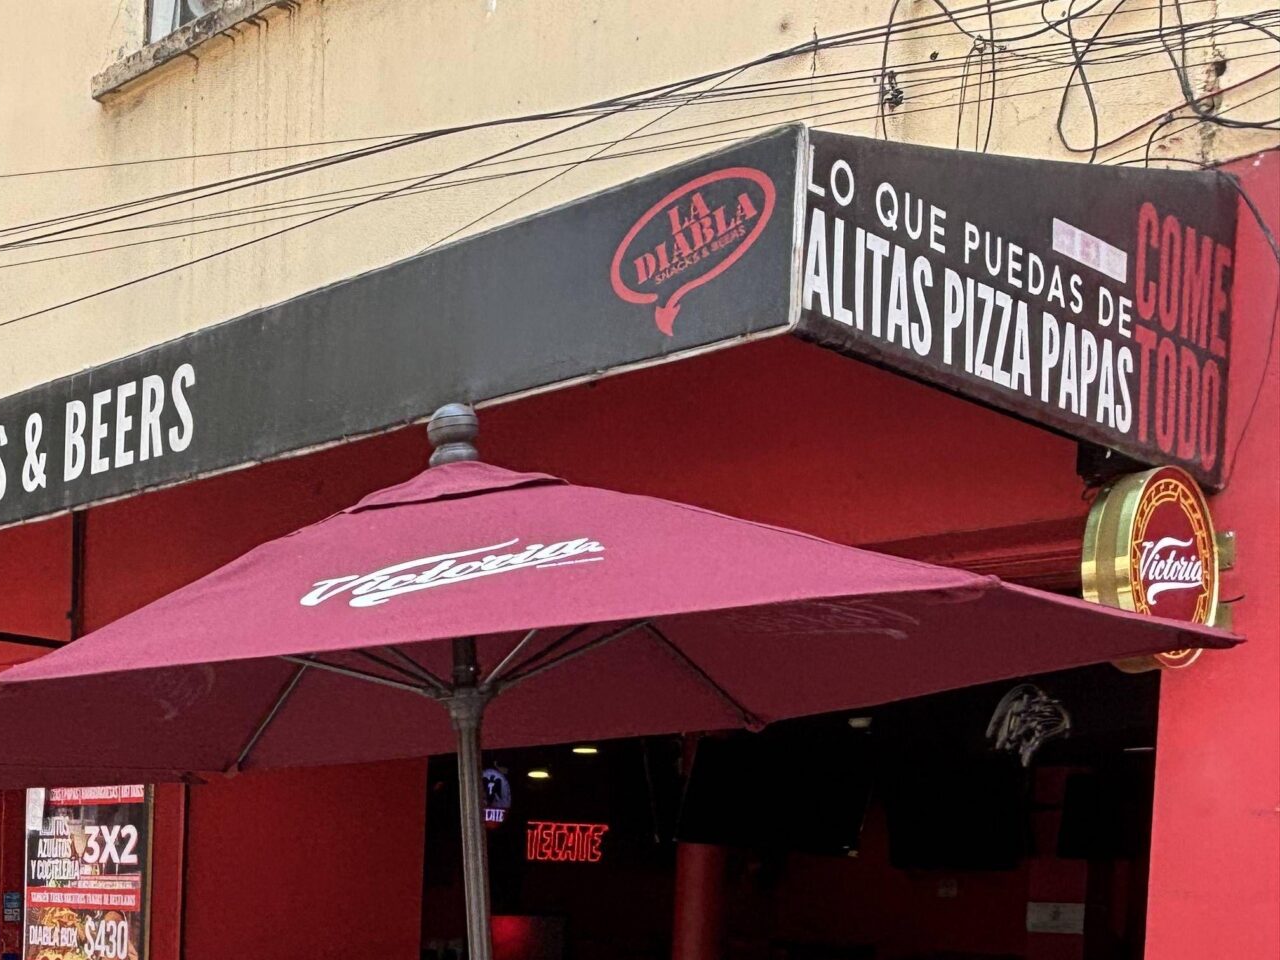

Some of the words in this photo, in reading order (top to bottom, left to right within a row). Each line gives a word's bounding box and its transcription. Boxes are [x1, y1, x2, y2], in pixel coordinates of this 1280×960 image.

[632, 193, 758, 285] DIABLA
[667, 192, 710, 235] LA
[807, 144, 855, 206] LO
[876, 181, 947, 254] QUE
[964, 221, 1083, 314] PUEDAS
[1098, 286, 1133, 338] DE
[1135, 202, 1232, 358] COME
[802, 207, 934, 357] ALITAS
[944, 267, 1032, 397] PIZZA
[1040, 311, 1134, 434] PAPAS
[21, 412, 47, 493] &
[63, 363, 196, 483] BEERS
[1135, 323, 1221, 472] TODO
[299, 537, 606, 608] Victoria
[1139, 536, 1204, 606] Victoria
[30, 859, 37, 880] Y
[83, 824, 139, 864] 3X2
[527, 821, 609, 861] TECATE
[29, 924, 60, 947] DIABLA
[83, 914, 128, 960] $430
